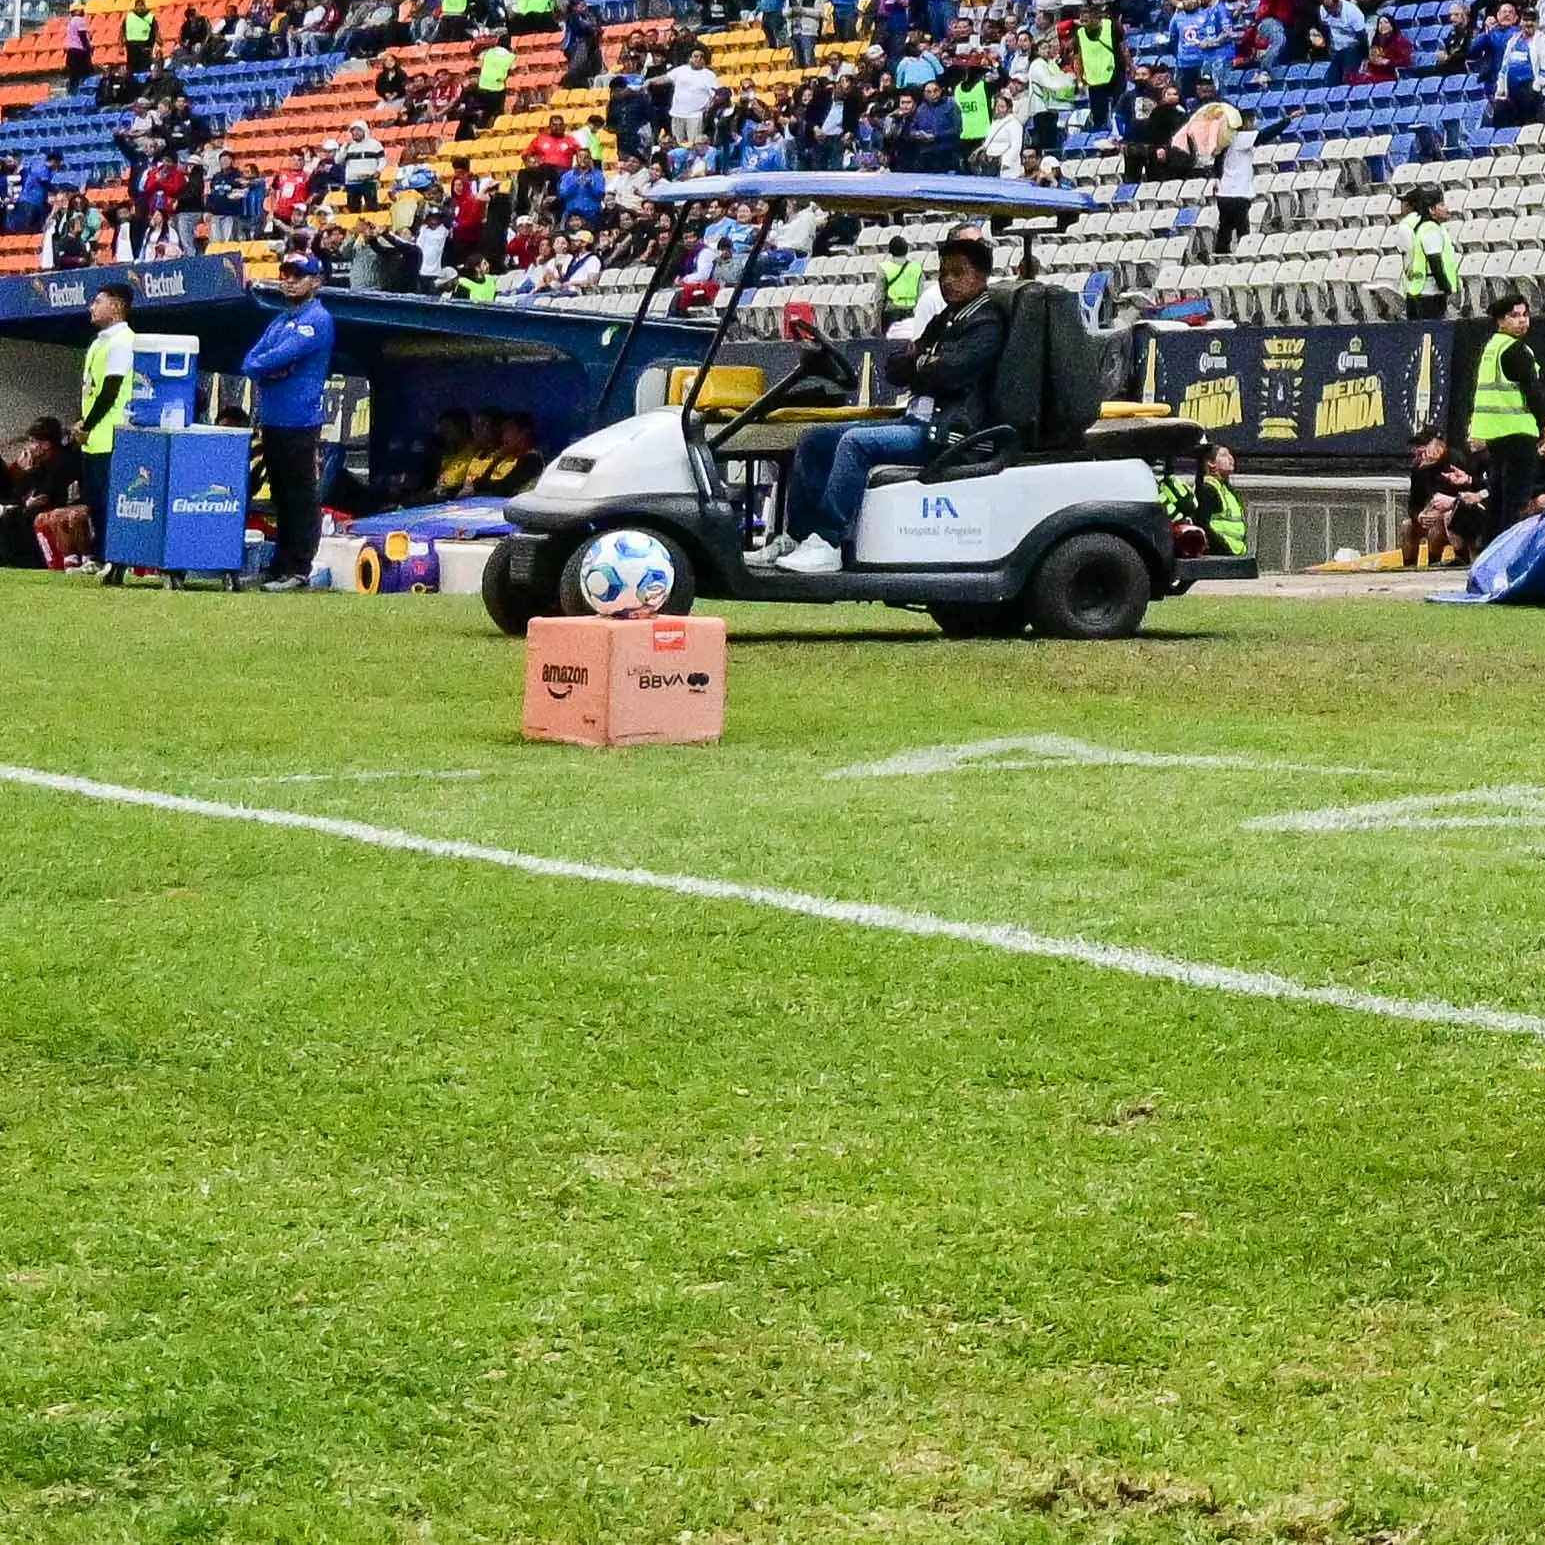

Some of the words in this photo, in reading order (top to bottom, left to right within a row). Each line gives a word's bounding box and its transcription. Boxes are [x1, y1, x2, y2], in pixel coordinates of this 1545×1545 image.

[172, 497, 241, 514] Electrolit
[897, 526, 940, 538] Hospital
[541, 663, 588, 685] amazon
[639, 674, 684, 689] BBVA
